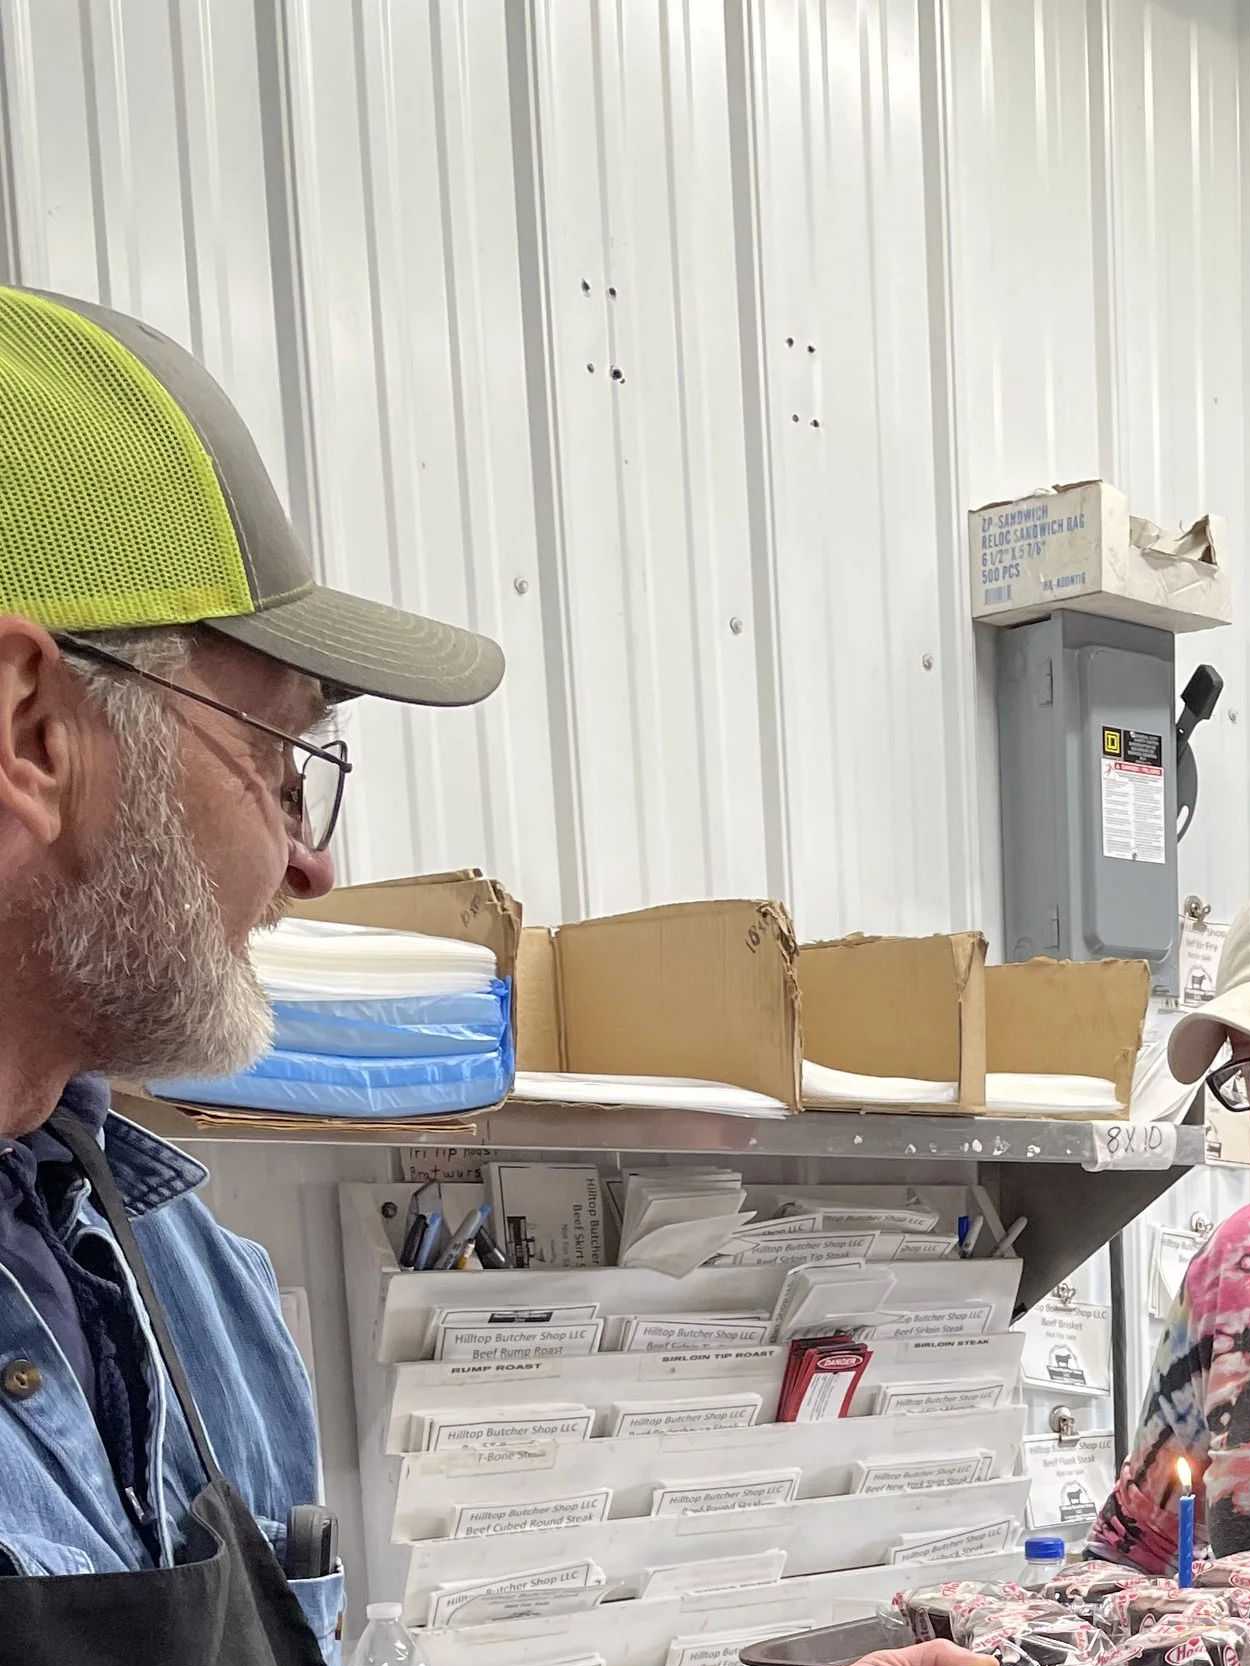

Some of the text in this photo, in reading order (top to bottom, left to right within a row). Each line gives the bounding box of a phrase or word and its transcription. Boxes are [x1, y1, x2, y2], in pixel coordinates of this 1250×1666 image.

[982, 513, 1085, 549] RELOC SANDWICH BAG
[982, 552, 987, 567] 6
[1011, 546, 1017, 561] X
[982, 563, 1020, 584] 500 PCS
[585, 1178, 601, 1265] Hilltop Butcher
[885, 1215, 907, 1223] Shop
[909, 1217, 926, 1225] LLC
[572, 1204, 586, 1259] Beef Skirt
[787, 1223, 804, 1234] LLC
[785, 1242, 821, 1251] Butcher
[824, 1240, 847, 1249] Shop
[849, 1239, 865, 1247] LLC
[922, 1244, 940, 1252] LLC
[810, 1253, 824, 1262] Tip
[914, 1310, 984, 1323] Butcher Shop LLC
[1093, 1309, 1108, 1319] LLC
[1041, 1317, 1057, 1326] Beef
[643, 1327, 674, 1338] Hilltop
[676, 1328, 714, 1339] Butcher
[716, 1329, 738, 1340] Shop
[740, 1331, 757, 1340] LLC
[894, 1324, 964, 1336] Beef Sirloin Steak
[454, 1329, 588, 1345] Hilltop Butcher Shop LLC
[914, 1338, 989, 1348] SIRLOIN STEAK
[472, 1346, 564, 1361] Beef Rump Roast
[662, 1350, 775, 1363] SIRLOIN TIP ROAST
[451, 1362, 543, 1374] RUMP ROAST
[824, 1358, 857, 1366] DANGER
[980, 1391, 994, 1399] LLC
[629, 1410, 747, 1427] Hilltop Butcher Shop LLC
[447, 1423, 579, 1440] Hilltop Butcher Shop LLC
[1079, 1441, 1097, 1450] Shop
[1098, 1440, 1112, 1449] LLC
[477, 1452, 514, 1463] T-Bone
[874, 1464, 972, 1481] Hilltop Butcher Shop LLC
[865, 1484, 885, 1494] Beef
[887, 1482, 904, 1491] New
[669, 1485, 784, 1505] Hilltop Butcher Shop LLC
[469, 1499, 599, 1521] Hilltop Butcher Shop LLC
[466, 1524, 491, 1535] Beef
[493, 1521, 527, 1532] Cubed
[529, 1516, 564, 1527] Round
[566, 1513, 595, 1523] Steak
[902, 1527, 1002, 1561] Hilltop Butcher Shop LLC
[486, 1581, 527, 1595] Butcher
[530, 1576, 558, 1588] Shop
[560, 1570, 579, 1580] LLC
[690, 1650, 721, 1661] Hilltop
